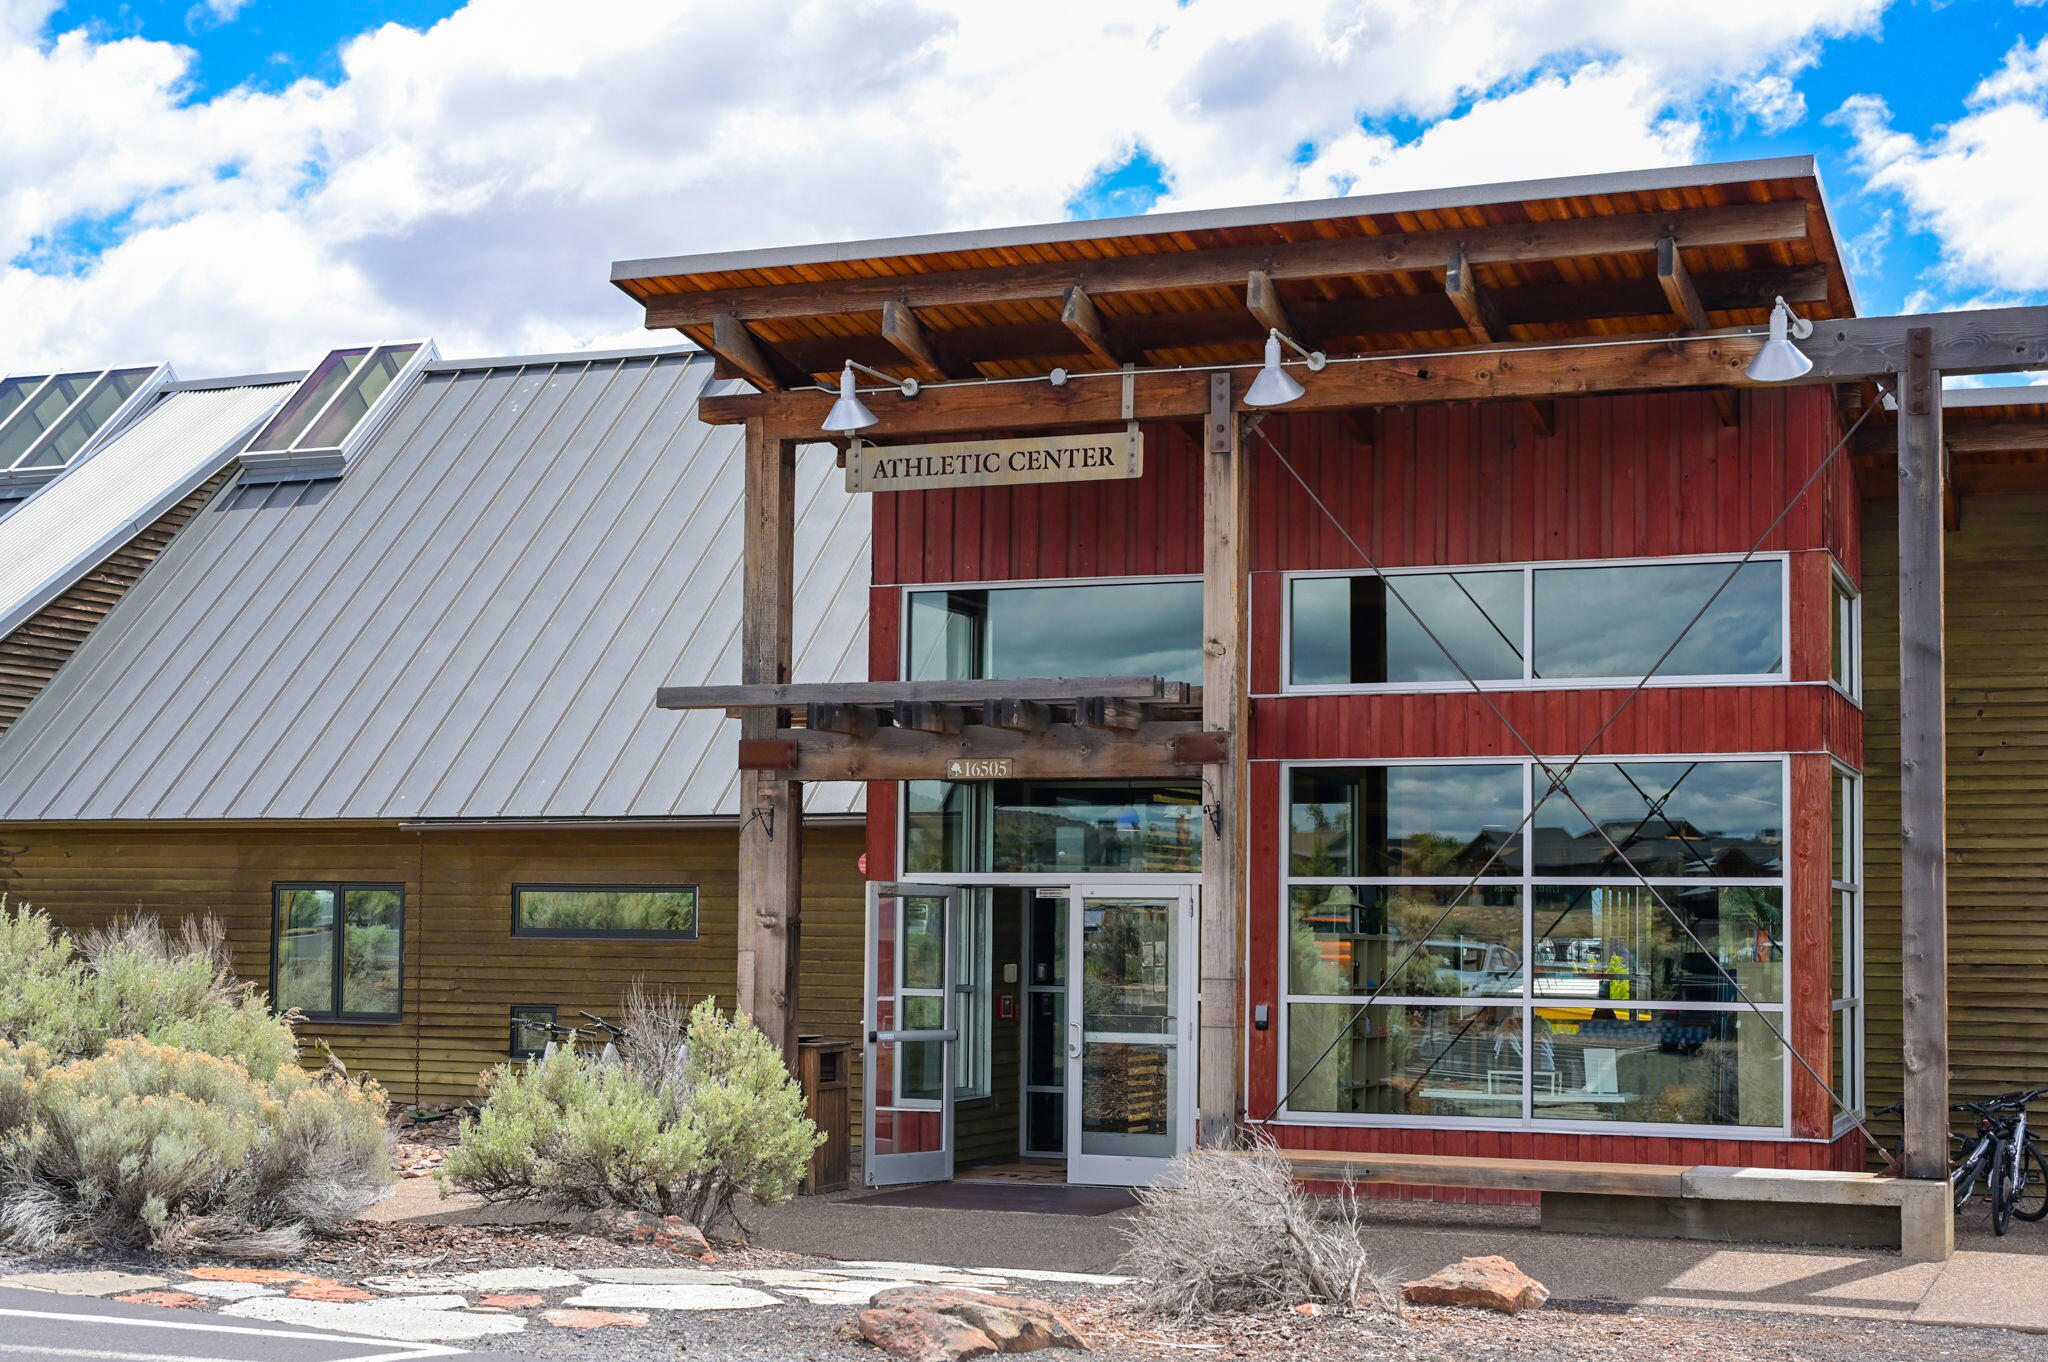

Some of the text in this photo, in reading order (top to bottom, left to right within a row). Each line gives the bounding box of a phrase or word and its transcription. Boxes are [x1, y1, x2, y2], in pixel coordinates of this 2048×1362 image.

[872, 446, 1116, 479] ATHLETIC CENTER
[965, 761, 1007, 777] 16505
